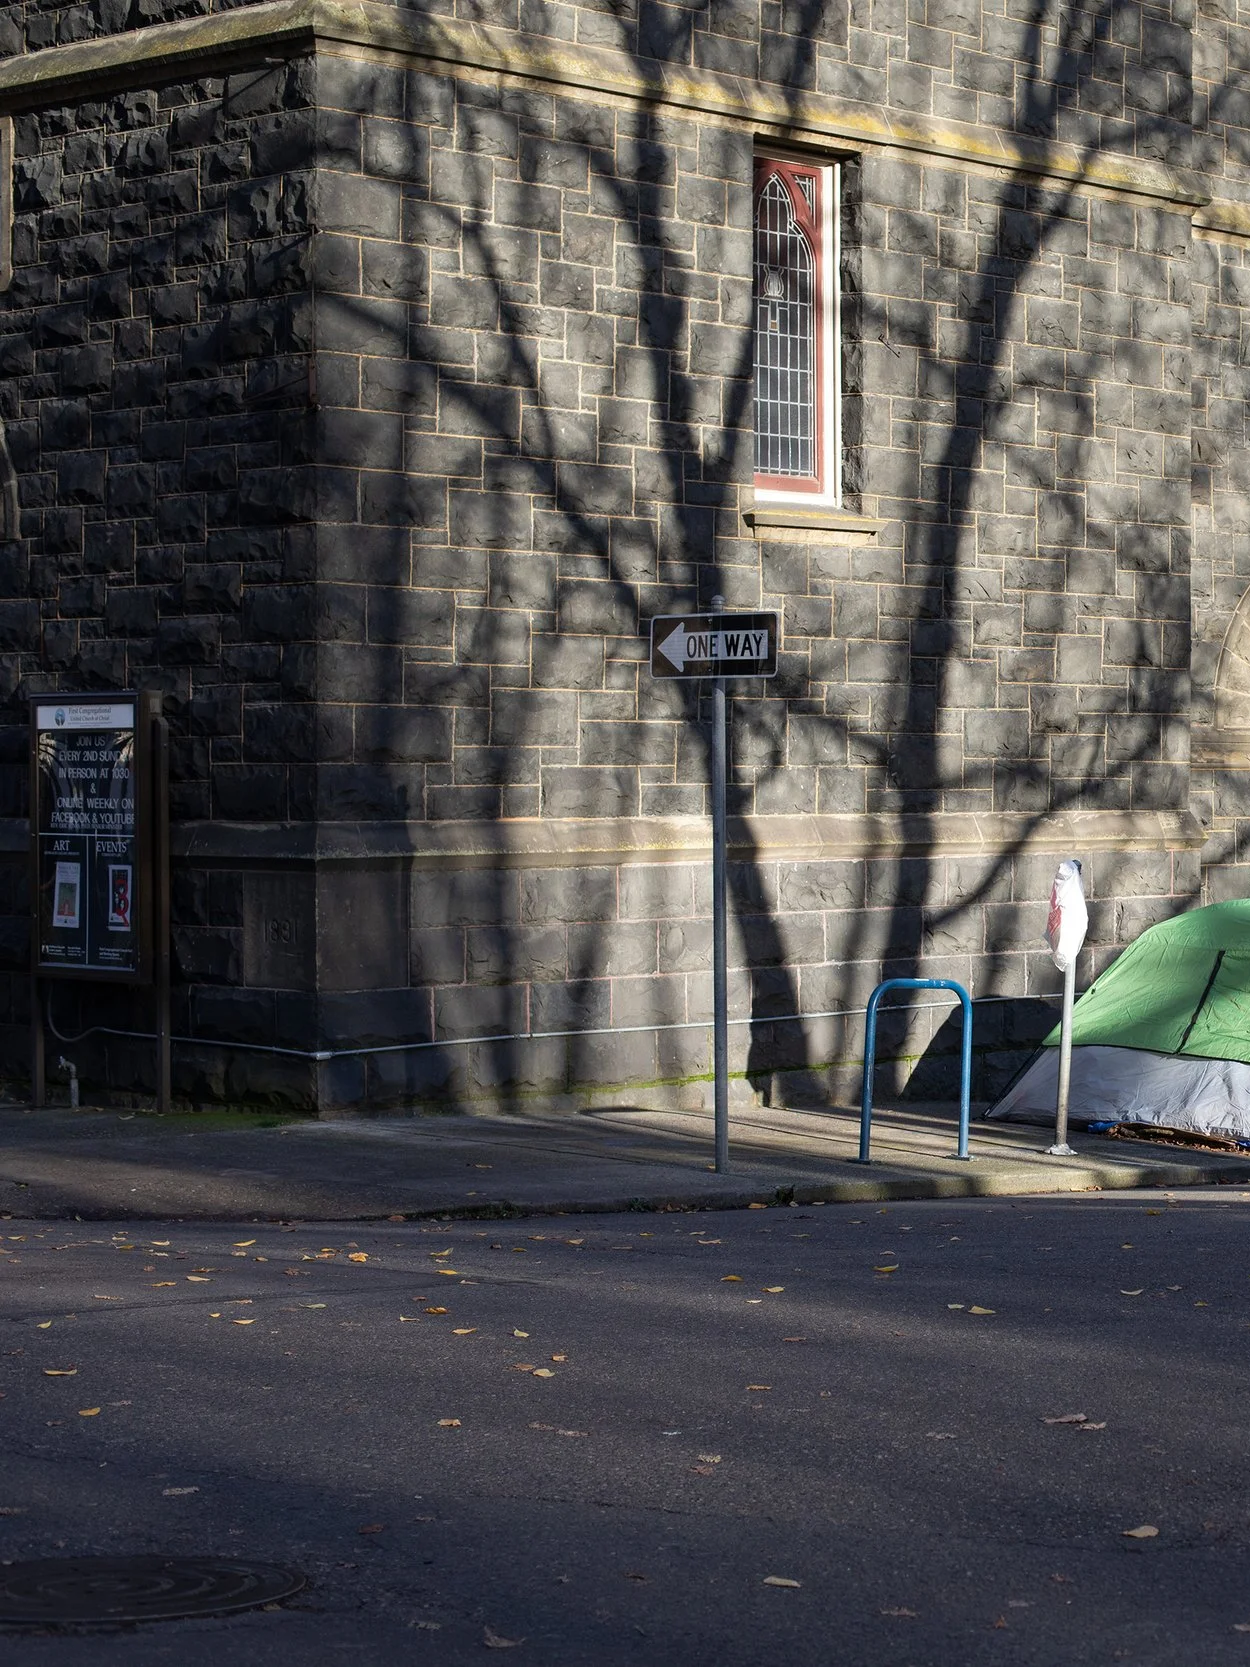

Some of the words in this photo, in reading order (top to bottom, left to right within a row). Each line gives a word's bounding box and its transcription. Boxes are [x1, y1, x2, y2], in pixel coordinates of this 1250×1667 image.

[686, 634, 718, 658] ONE
[724, 633, 763, 657] WAY
[76, 735, 92, 747] JOIN
[94, 735, 106, 746] US
[59, 750, 81, 761] EVERY
[83, 750, 98, 761] 2ND
[59, 767, 67, 778] IN
[68, 767, 97, 779] PERSON
[100, 767, 109, 779] AT
[90, 782, 97, 794] &
[57, 797, 83, 809] ONLINE
[87, 797, 119, 809] WEEKLY
[121, 798, 134, 809] ON
[51, 812, 90, 824] FACEBOOK
[92, 812, 98, 824] &
[53, 839, 71, 851] ART
[96, 840, 127, 853] EVENTS
[263, 918, 298, 944] 1891
